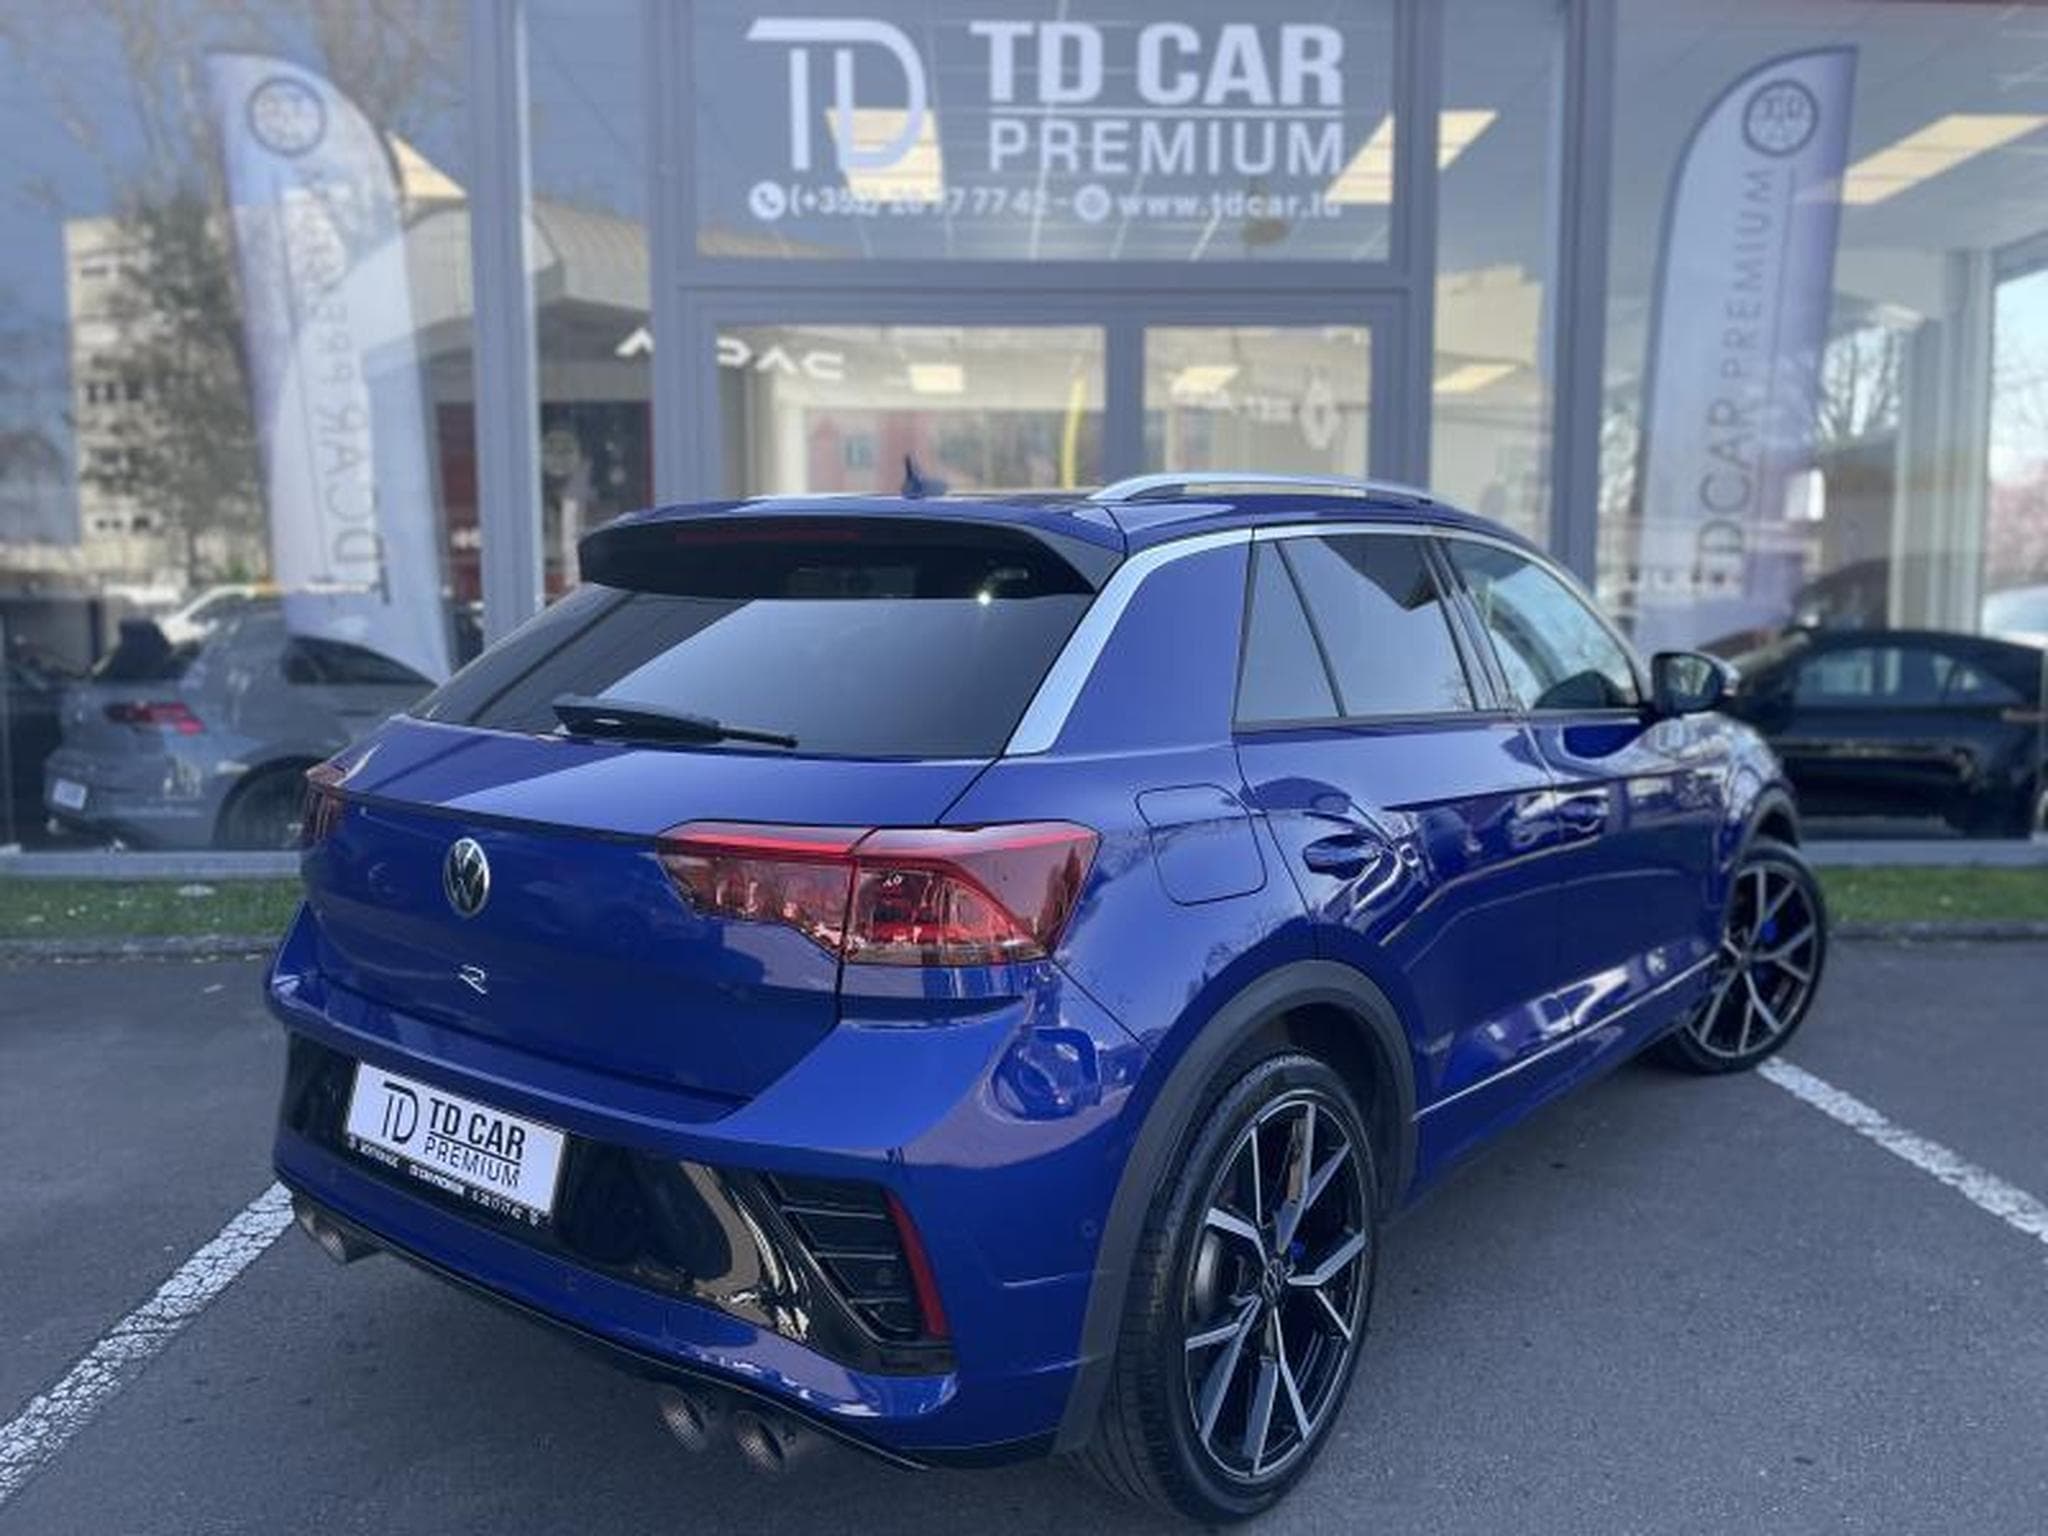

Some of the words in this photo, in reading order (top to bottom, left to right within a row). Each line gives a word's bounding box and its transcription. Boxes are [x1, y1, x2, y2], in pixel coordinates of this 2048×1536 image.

[970, 21, 1104, 104] TD
[1136, 22, 1344, 106] CAR
[988, 118, 1344, 176] PREMIUM
[1719, 168, 1776, 380] PREMIUM
[429, 1097, 462, 1137] TD
[467, 1112, 526, 1160] CAR
[424, 1136, 522, 1189] PREMIUM
